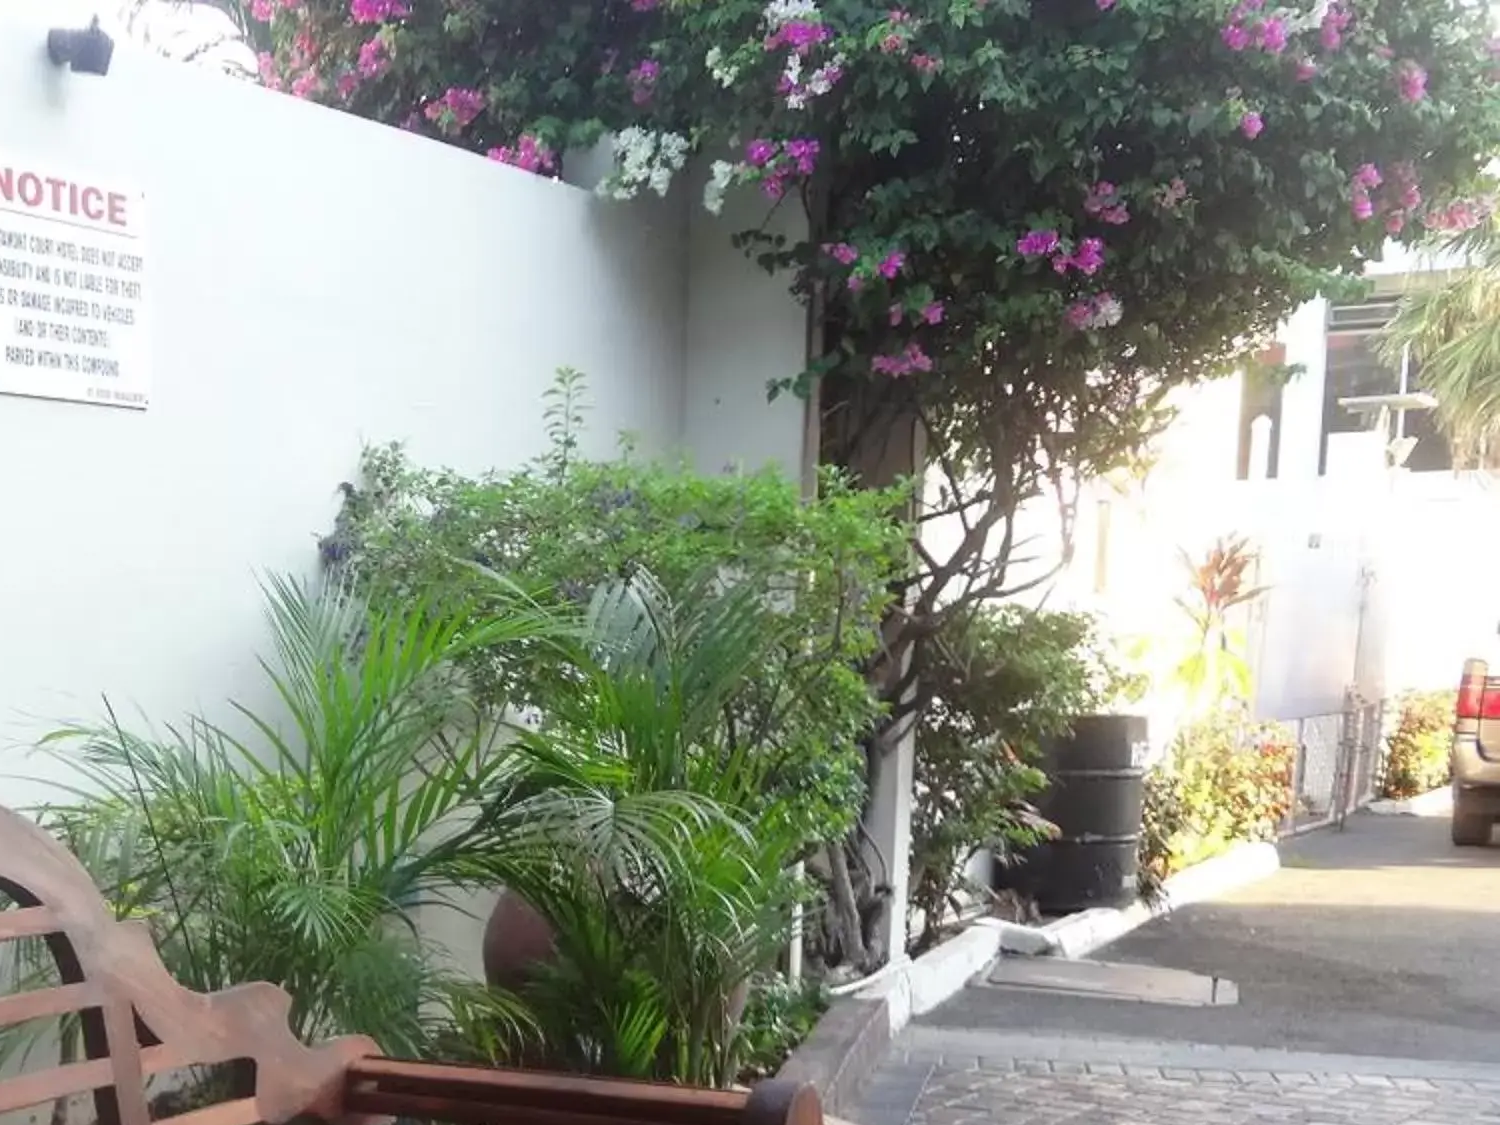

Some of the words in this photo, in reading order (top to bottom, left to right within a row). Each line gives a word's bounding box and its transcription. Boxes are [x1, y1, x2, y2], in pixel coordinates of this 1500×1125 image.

[29, 235, 54, 255] COURT
[81, 246, 98, 265] DOES
[101, 250, 115, 268] NOT
[117, 253, 143, 273] ACCEPT
[35, 265, 50, 284] AND
[54, 268, 60, 285] IS
[63, 270, 77, 289] NOT
[79, 273, 102, 293] LIABLE
[105, 277, 118, 296] FOR
[7, 288, 17, 305] OR
[21, 290, 51, 312] DAMAGE
[53, 297, 88, 318] INCURRED
[91, 303, 99, 320] TO
[5, 345, 34, 366] PARKED
[37, 350, 61, 369] WITHIN
[63, 353, 78, 372] THIS
